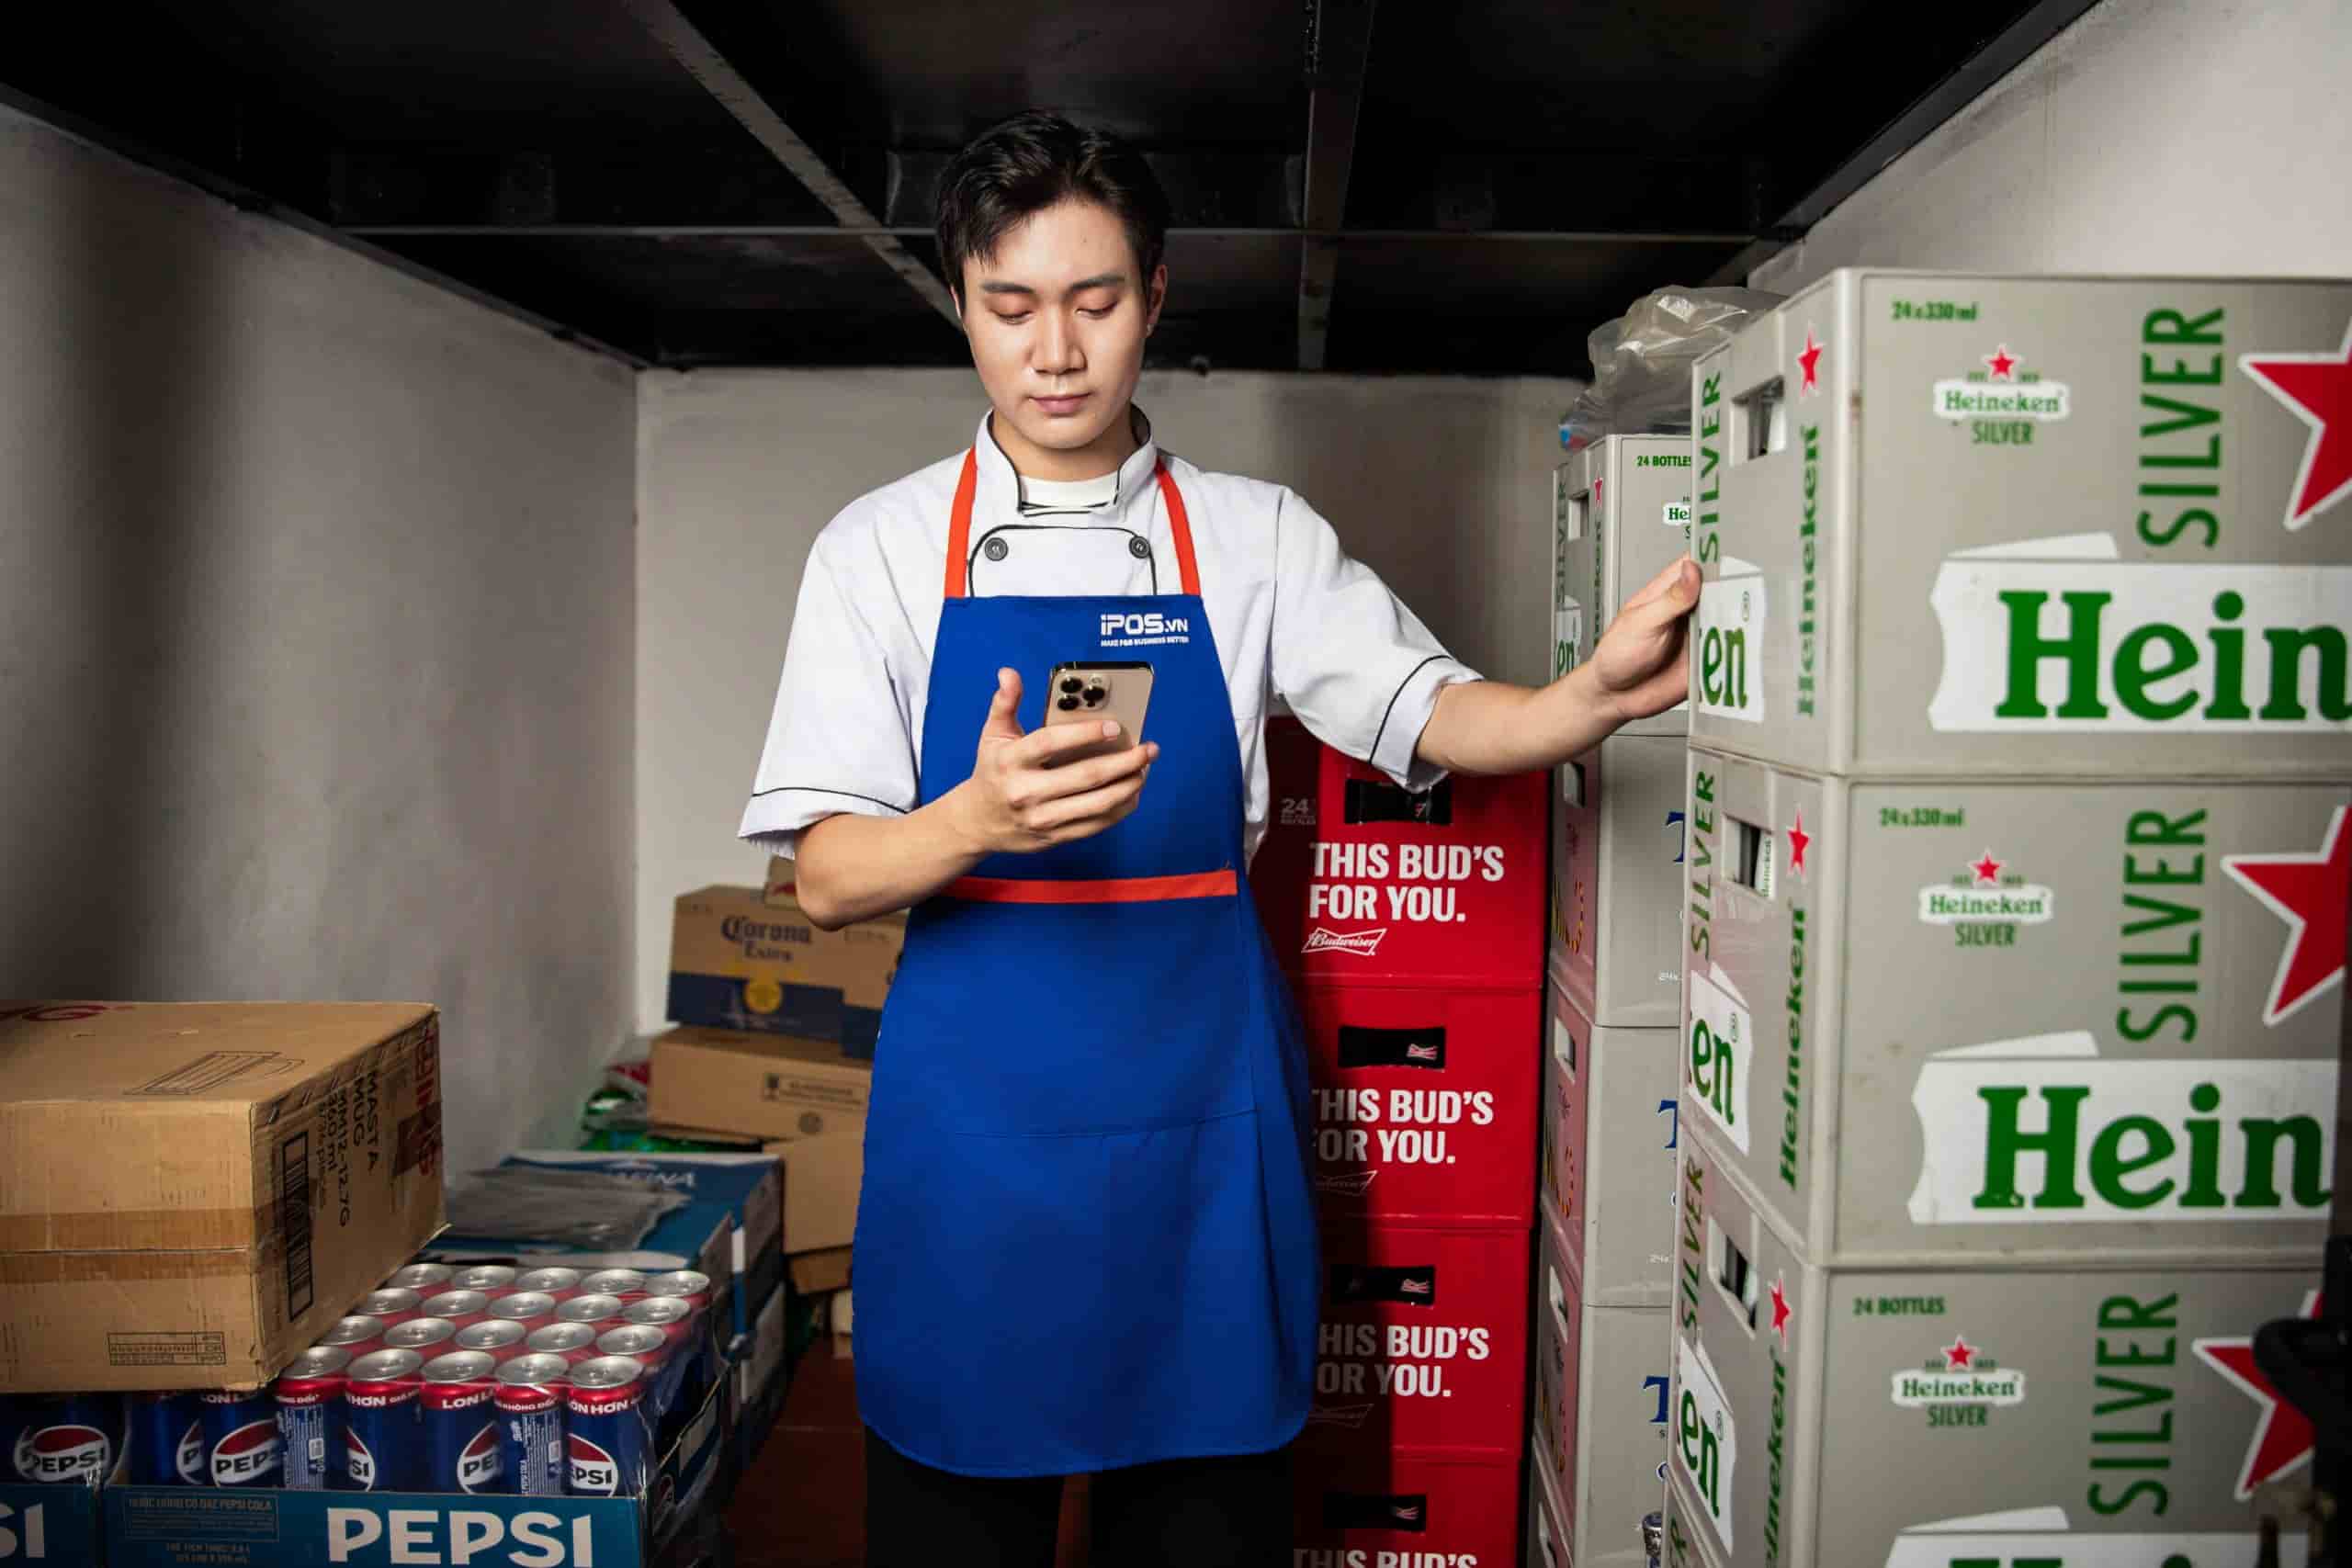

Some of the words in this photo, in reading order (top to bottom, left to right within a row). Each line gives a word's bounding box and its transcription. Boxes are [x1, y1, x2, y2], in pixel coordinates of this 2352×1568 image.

[1945, 390, 2059, 412] Heineken
[1972, 422, 2033, 445] SILVER
[2137, 308, 2224, 548] SILVER
[1636, 456, 1649, 467] 24
[1699, 370, 1721, 563] SILVER
[1799, 425, 1819, 716] Heineken
[1280, 798, 1308, 814] 24
[1310, 842, 1389, 879] THIS
[1398, 844, 1505, 882] BUD'S
[1690, 771, 1714, 961] SILVER
[1309, 885, 1377, 919] FOR
[1386, 886, 1466, 922] YOU.
[1929, 894, 2044, 914] Heineken
[721, 916, 812, 943] Corona
[1955, 923, 2015, 946] SILVER
[2117, 808, 2208, 1043] SILVER
[1779, 908, 1806, 1192] Heineken
[353, 1077, 366, 1147] MUG
[1312, 1089, 1381, 1122] HIS
[1388, 1089, 1494, 1125] BUD'S
[1313, 1130, 1368, 1162] OR
[1377, 1130, 1456, 1164] YOU.
[1972, 1083, 2331, 1210] Hein
[1681, 1155, 1704, 1330] SILVER
[1853, 1297, 1873, 1314] 24
[1878, 1297, 1946, 1314] BOTTLES
[1318, 1325, 1376, 1357] HIS
[1385, 1325, 1491, 1360] BUD'S
[1317, 1362, 1365, 1394] OR
[1374, 1364, 1452, 1397] YOU.
[1903, 1377, 2016, 1397] Heineken
[442, 1395, 480, 1409] LON
[591, 1400, 629, 1416] HƠN
[1928, 1405, 1987, 1427] SILVER
[2087, 1291, 2178, 1517] SILVER
[33, 1445, 105, 1473] PEPSI
[352, 1462, 369, 1477] SI
[464, 1457, 493, 1478] PE
[327, 1507, 594, 1568] PEPSI
